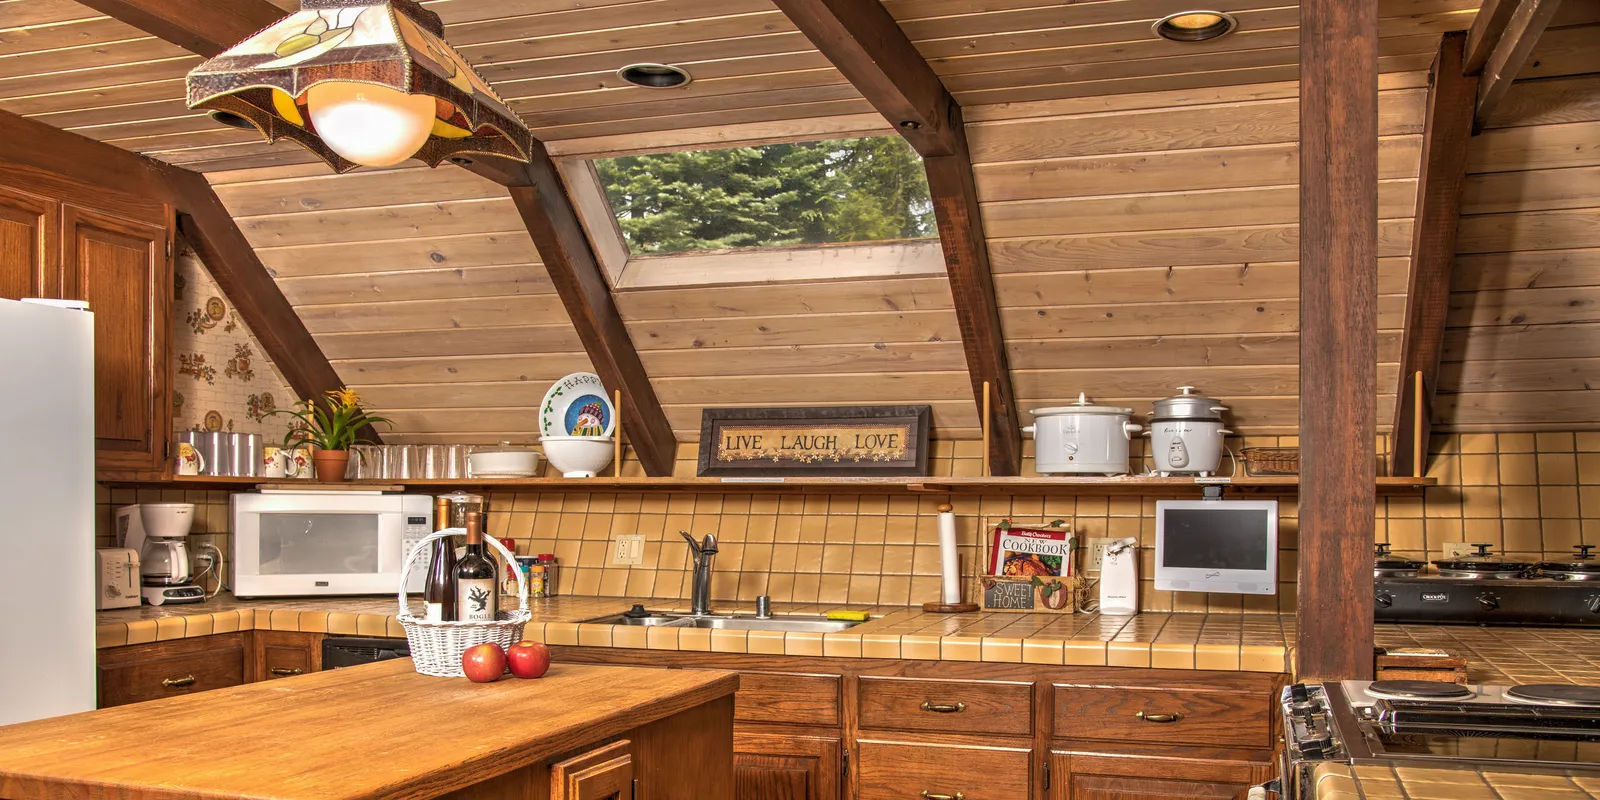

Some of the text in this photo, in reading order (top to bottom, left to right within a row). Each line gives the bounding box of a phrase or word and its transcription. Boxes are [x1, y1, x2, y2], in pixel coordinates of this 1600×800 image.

[726, 433, 899, 450] LIVE LAUGH LOVE
[1002, 538, 1068, 555] COOKBOOK
[995, 582, 1032, 598] SWEET
[993, 593, 1027, 609] HOME
